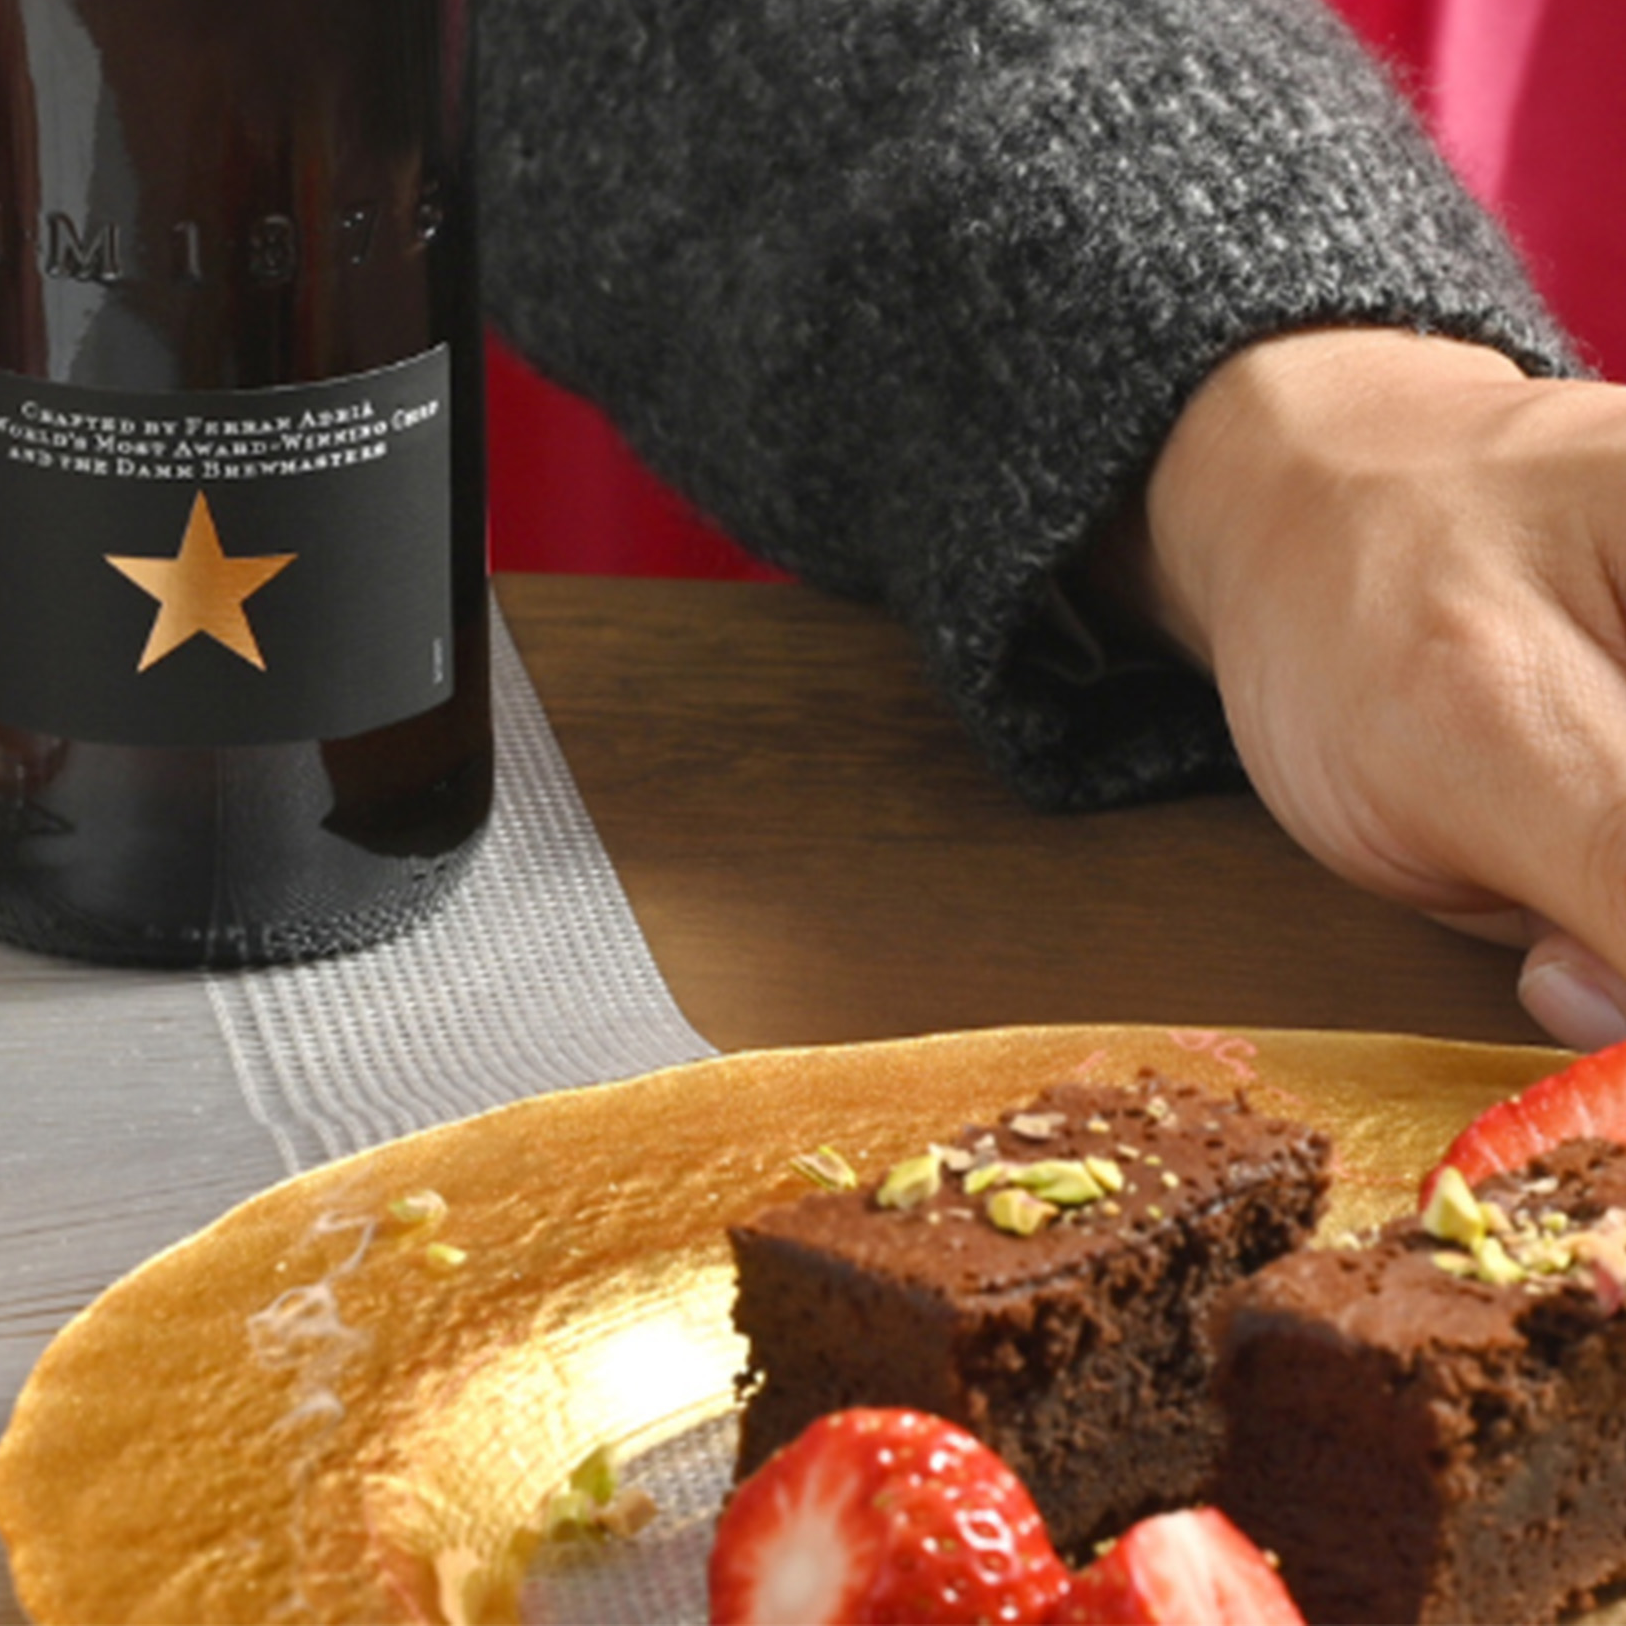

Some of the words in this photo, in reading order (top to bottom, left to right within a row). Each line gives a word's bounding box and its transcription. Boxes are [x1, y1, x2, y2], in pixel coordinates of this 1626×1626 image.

[21, 399, 135, 434] CRAFTED
[143, 419, 178, 436] BY
[184, 416, 292, 437] FERRAN
[7, 445, 53, 468] AND
[59, 453, 109, 476] THE
[116, 457, 194, 480] DAMM
[202, 440, 387, 480] BREWMASTERS
[94, 433, 167, 458] MOST
